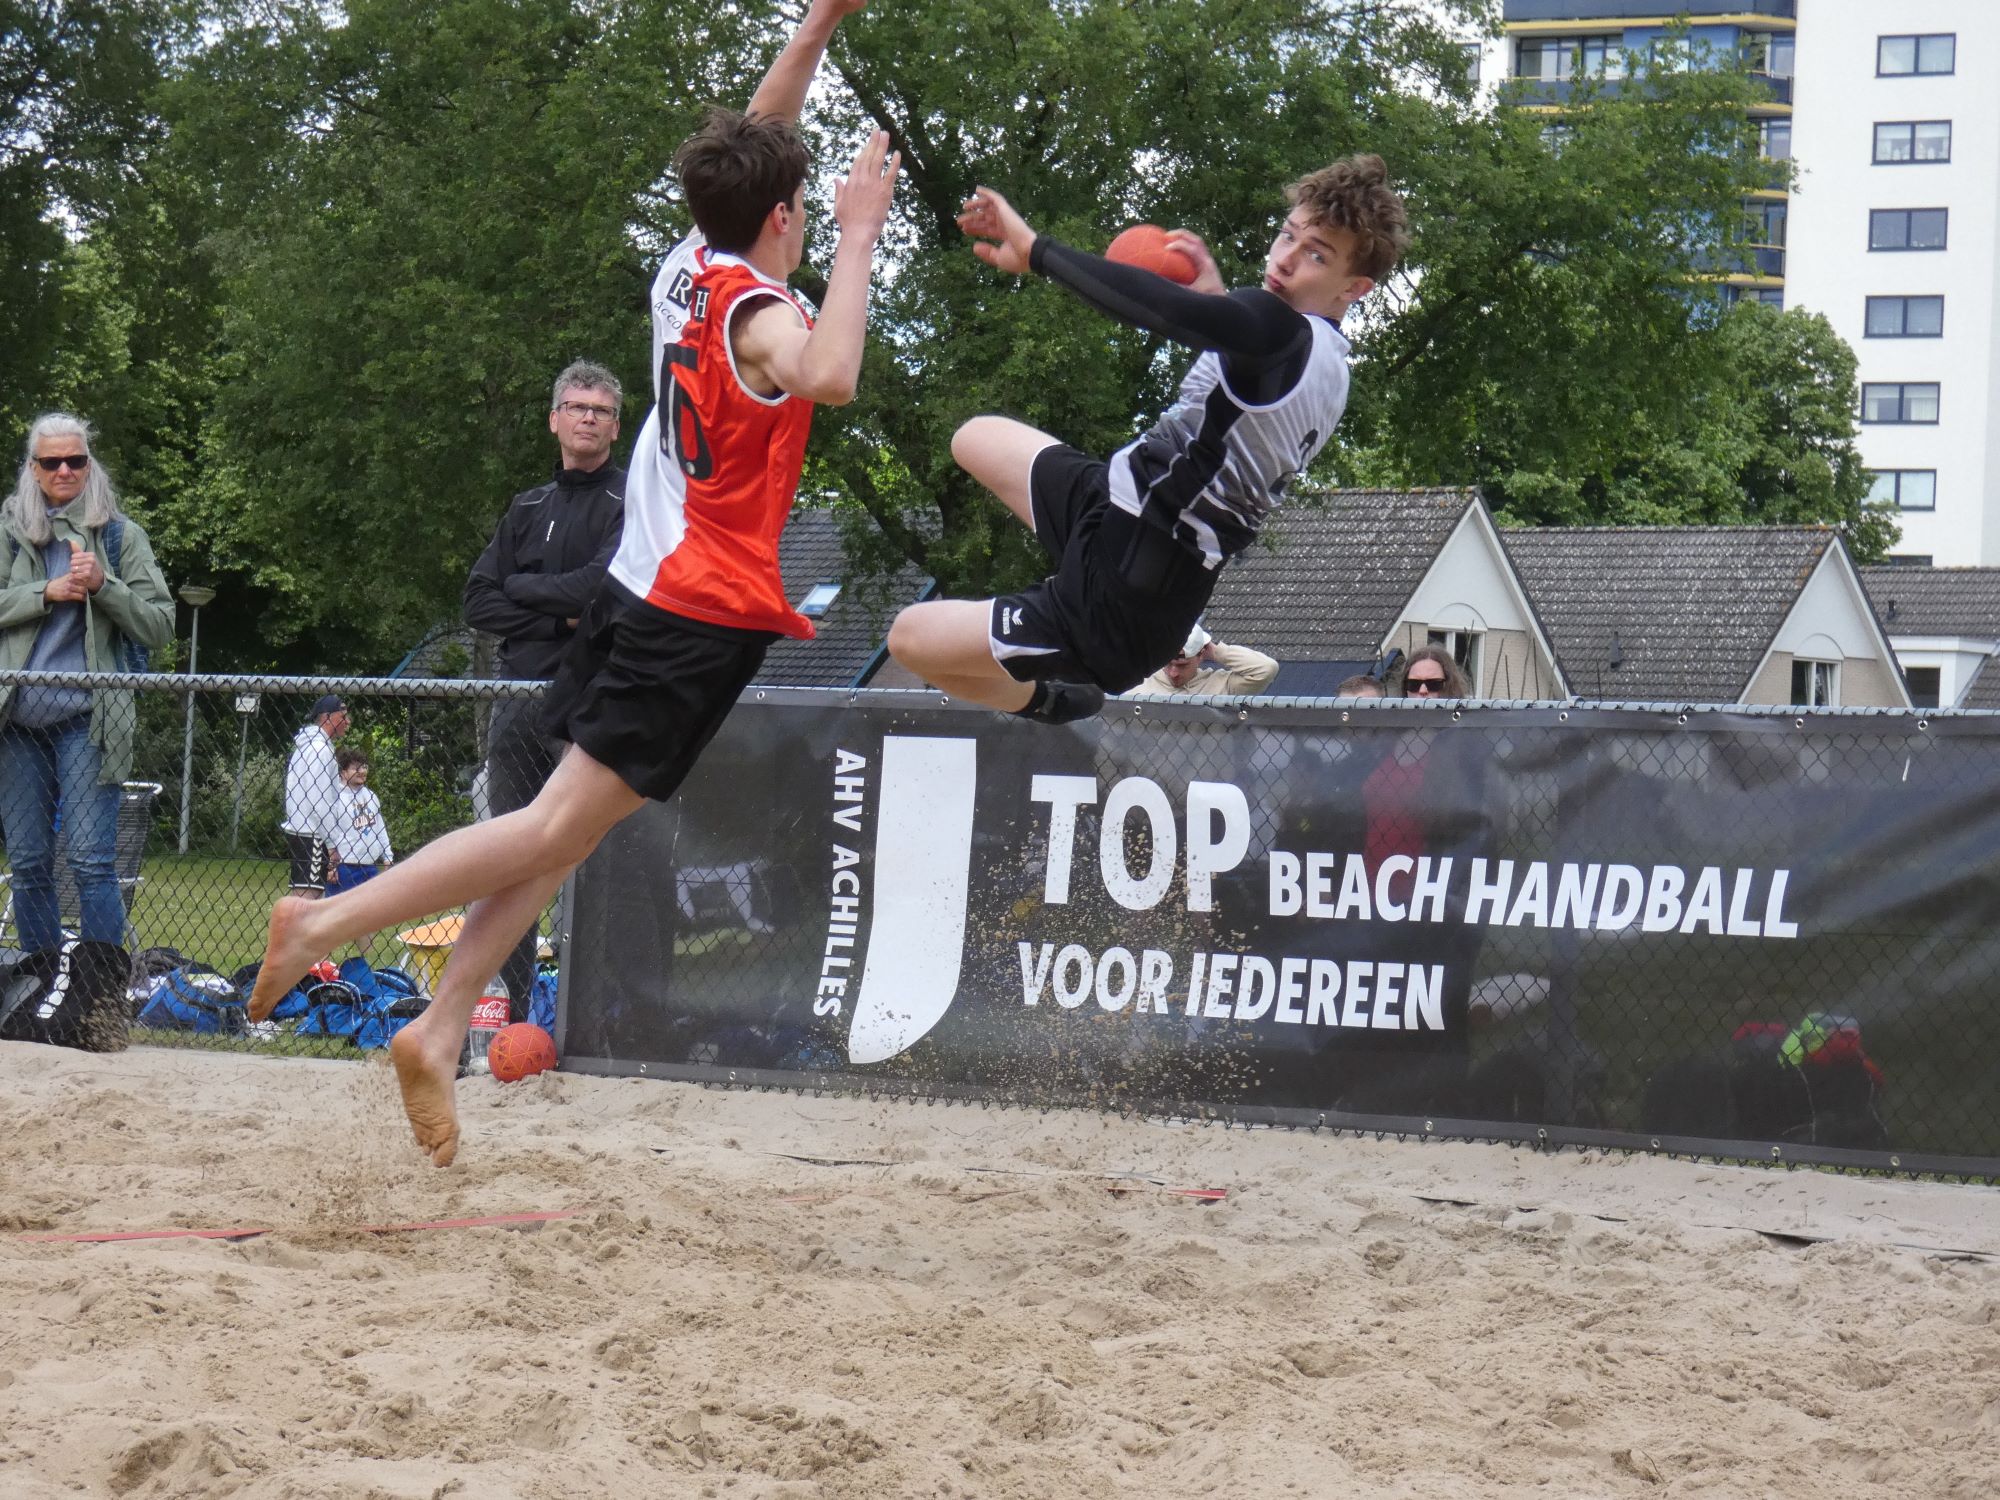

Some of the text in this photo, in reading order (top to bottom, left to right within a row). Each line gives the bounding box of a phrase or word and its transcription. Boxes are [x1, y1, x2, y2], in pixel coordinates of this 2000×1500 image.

[813, 748, 867, 1018] AHV ACHILLES
[1030, 774, 1798, 938] TOP BEACH HANDBALL
[1018, 941, 1445, 1031] VOOR IEDEREEN
